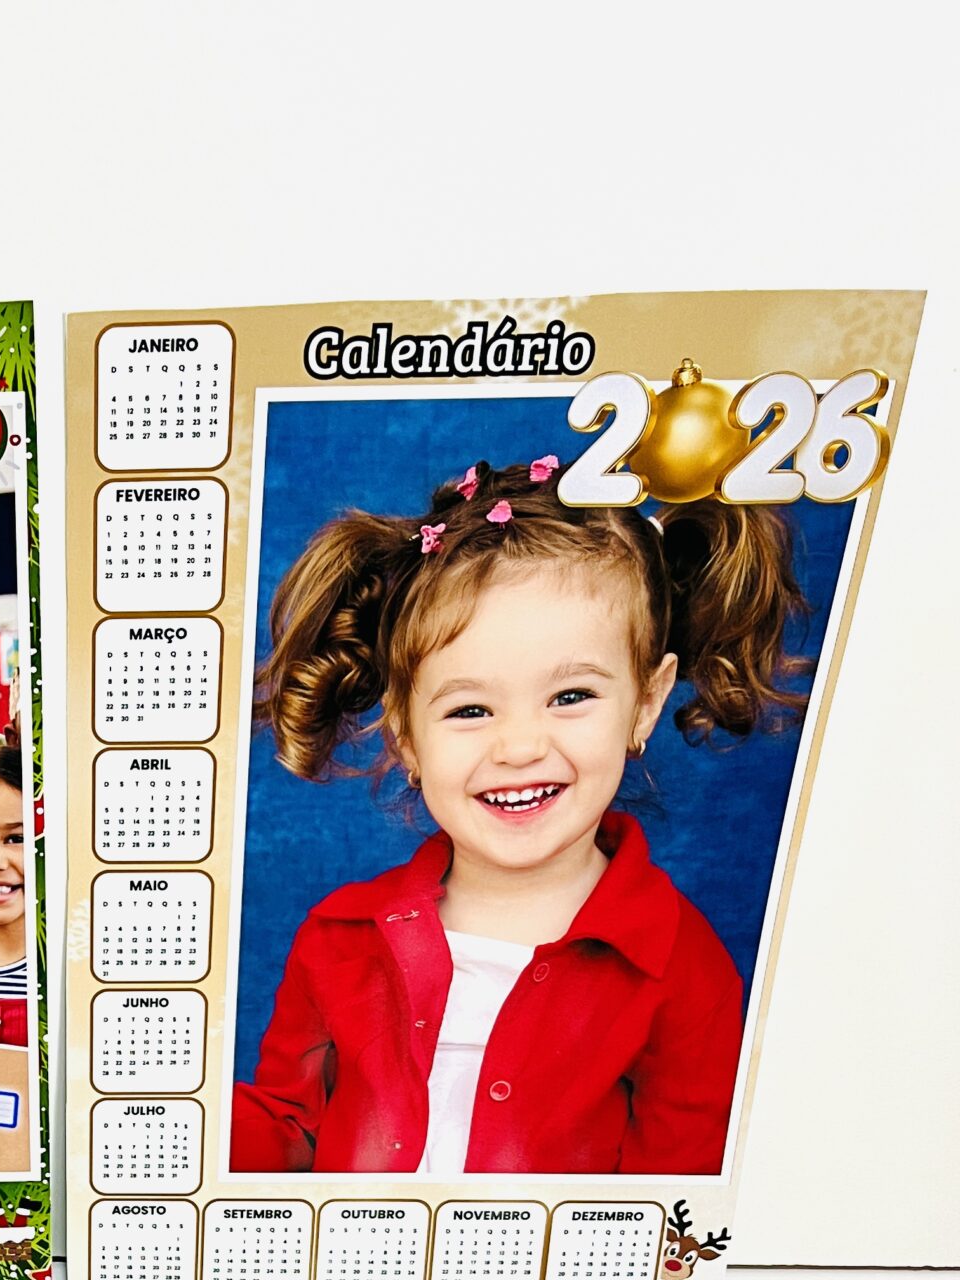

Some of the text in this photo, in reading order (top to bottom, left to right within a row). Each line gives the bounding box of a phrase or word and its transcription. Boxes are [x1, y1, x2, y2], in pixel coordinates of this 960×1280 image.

[128, 337, 199, 354] JANEIRO
[306, 317, 594, 379] Calendário
[110, 405, 218, 416] 11 12 13 14 15 16 17
[109, 430, 217, 441] 25 26 27 28 29 30 31
[115, 487, 201, 503] FEVEREIRO
[104, 570, 212, 580] 22 23 24 25 26 27 28
[129, 627, 188, 645] MARÇO
[129, 758, 172, 771] ABRIL
[129, 879, 169, 892] MAIO
[122, 997, 170, 1009] JUNHO
[123, 1105, 166, 1116] JULHO
[111, 1205, 167, 1216] AGOSTO
[223, 1208, 293, 1220] SETEMBRO
[340, 1209, 406, 1220] OUTUBRO
[452, 1210, 531, 1221] NOVEMBRO
[571, 1210, 645, 1222] DEZEMBRO
